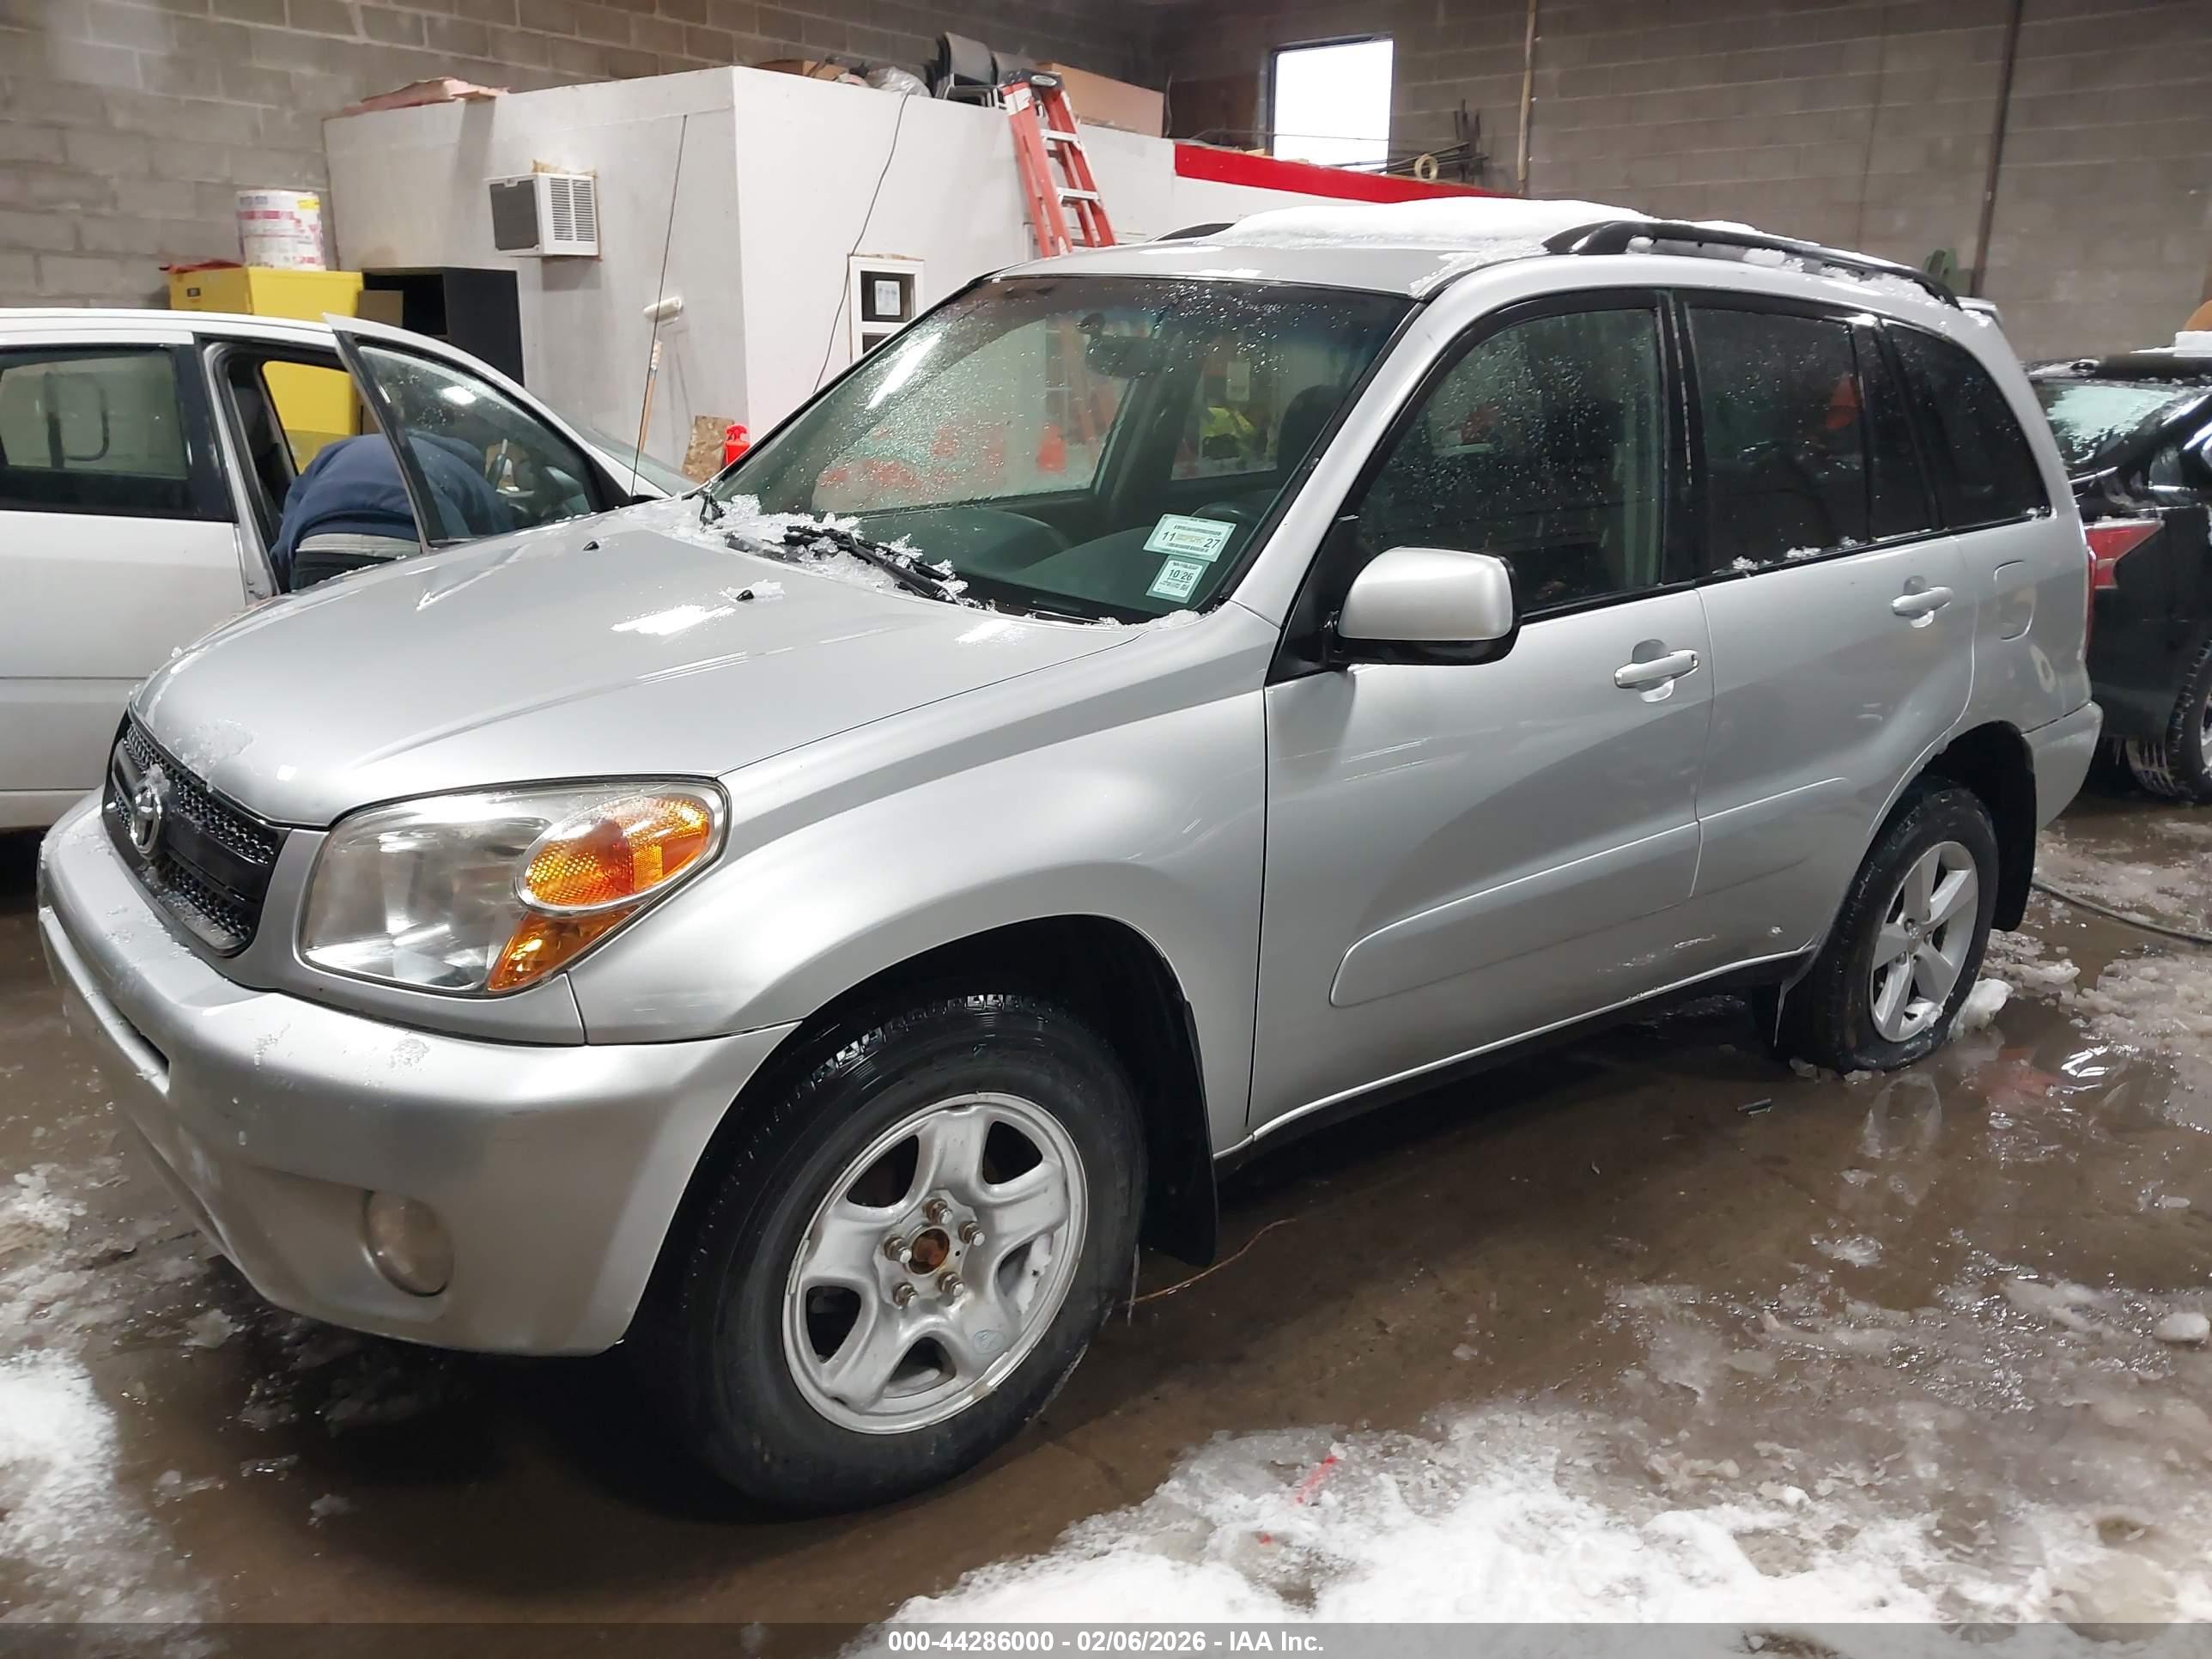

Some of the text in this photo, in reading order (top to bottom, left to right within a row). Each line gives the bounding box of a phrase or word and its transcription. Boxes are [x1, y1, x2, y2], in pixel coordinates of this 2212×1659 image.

[1161, 531, 1176, 542] 11
[1203, 538, 1221, 550] 27
[1170, 568, 1194, 581] 10 26
